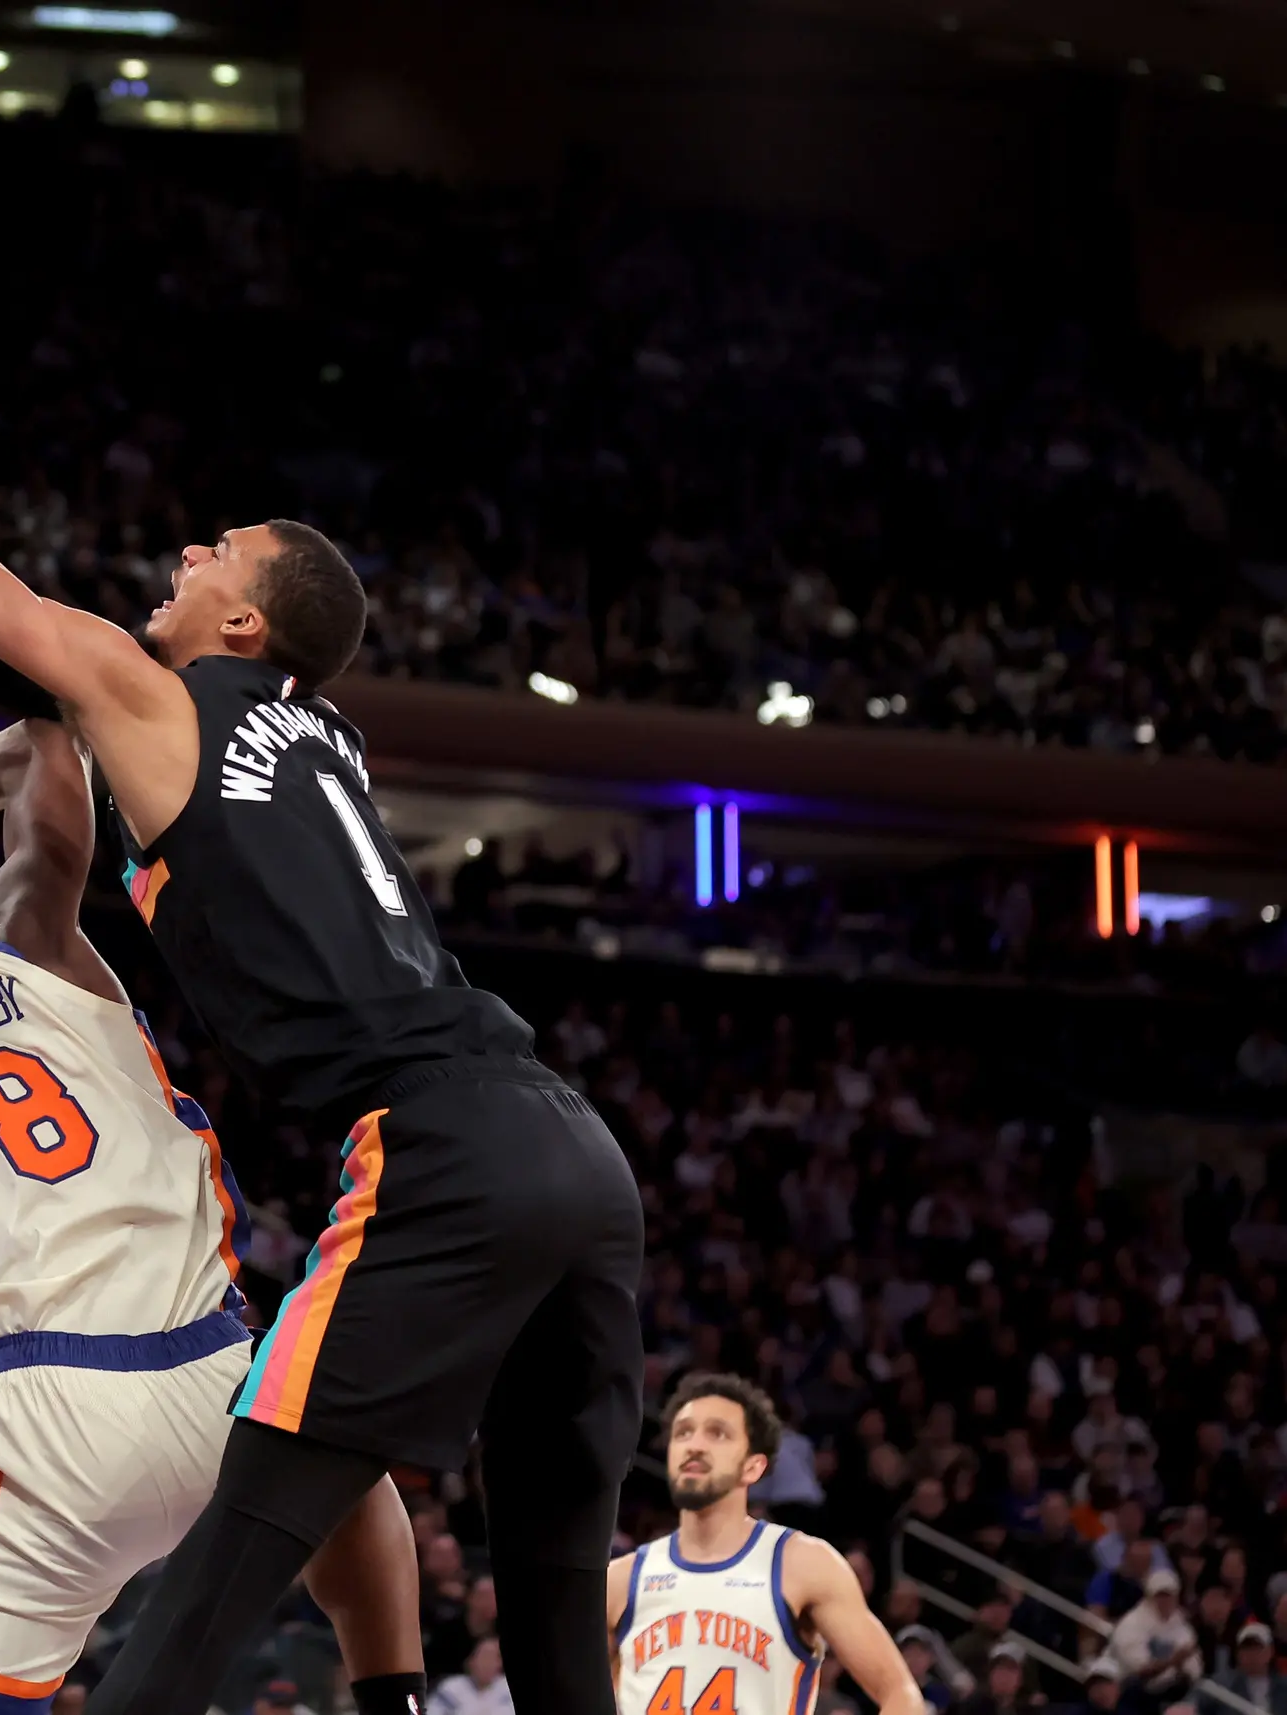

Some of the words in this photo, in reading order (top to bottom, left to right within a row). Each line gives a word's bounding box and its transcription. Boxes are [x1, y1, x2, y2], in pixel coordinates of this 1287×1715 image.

[314, 769, 409, 917] 1
[633, 1610, 687, 1674] NEW
[694, 1609, 774, 1672] YORK
[645, 1665, 739, 1715] 44
